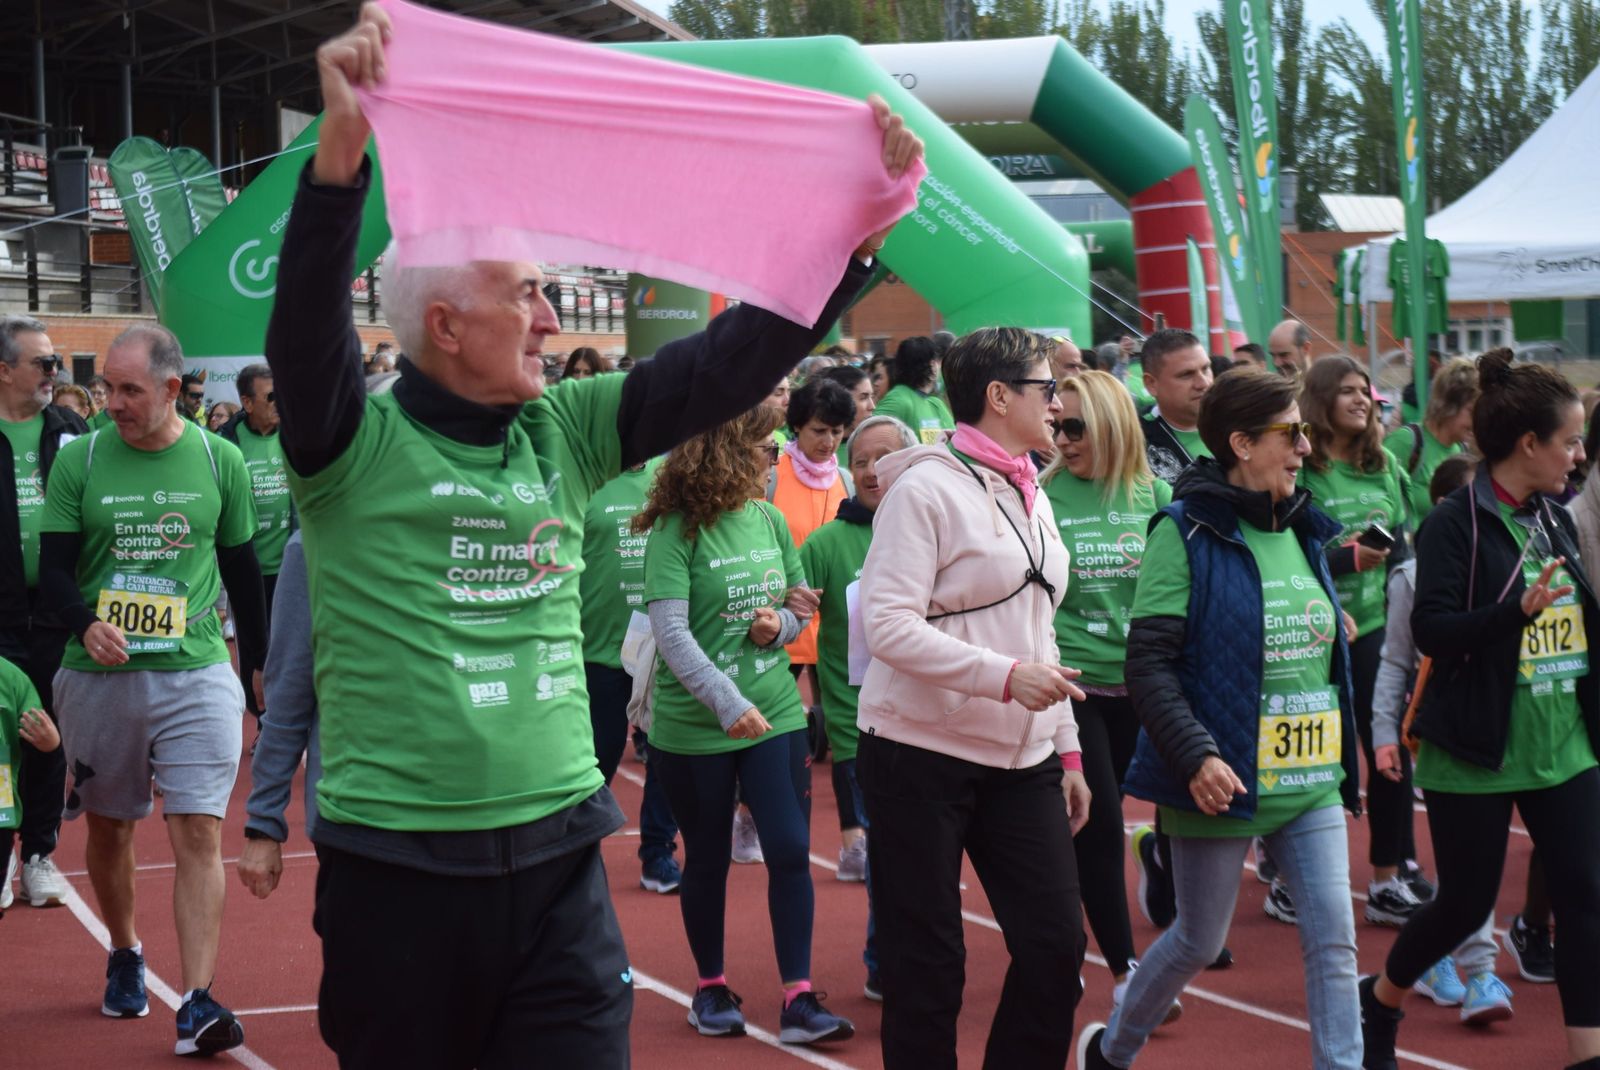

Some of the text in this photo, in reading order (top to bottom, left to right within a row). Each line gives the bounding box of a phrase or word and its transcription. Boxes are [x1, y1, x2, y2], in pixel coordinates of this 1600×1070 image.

[937, 208, 983, 245] cáncer
[636, 309, 697, 320] IBERDROLA
[208, 370, 239, 383] Iberd
[253, 482, 280, 490] contra
[113, 511, 144, 519] ZAMORA
[115, 521, 190, 535] En marcha
[451, 516, 506, 530] ZAMORA
[116, 535, 161, 547] contra
[1075, 542, 1094, 553] En
[115, 548, 180, 560] el cáncer
[450, 535, 485, 561] En
[1076, 553, 1123, 566] contra
[447, 563, 529, 582] contra
[725, 571, 751, 582] ZAMORA
[1078, 567, 1092, 580] el
[126, 582, 176, 595] CAJA RURAL
[450, 577, 563, 602] el cáncer
[727, 586, 745, 599] En
[727, 595, 768, 611] contra
[1264, 599, 1290, 608] AMORA
[107, 601, 174, 635] 8084
[726, 611, 739, 623] el
[1264, 614, 1283, 629] En
[1264, 629, 1310, 646] contra
[1527, 617, 1572, 655] 8112
[144, 640, 176, 650] RURAL
[1264, 645, 1325, 663] el cáncer
[468, 681, 509, 704] gaza
[1274, 718, 1324, 759] 3111
[1280, 771, 1336, 786] CAJA RURAL
